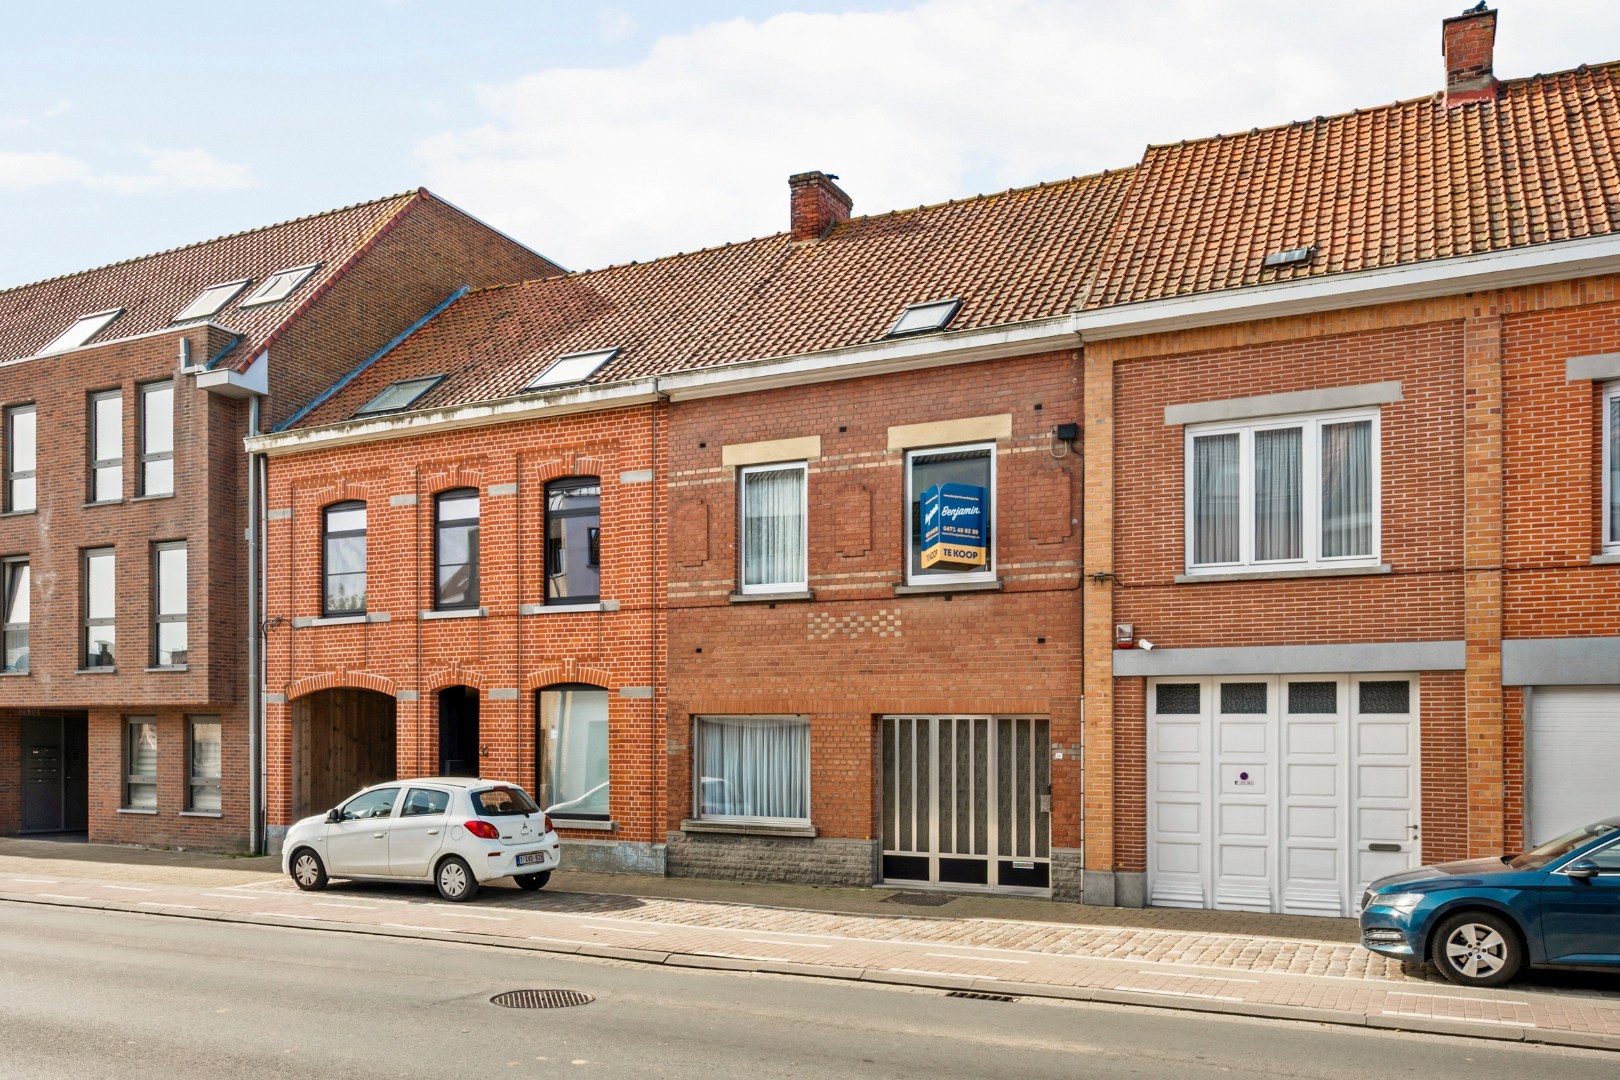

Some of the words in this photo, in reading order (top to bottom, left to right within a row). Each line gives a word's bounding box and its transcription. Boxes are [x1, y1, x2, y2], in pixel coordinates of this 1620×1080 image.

[942, 525, 956, 533] 0471
[943, 548, 952, 557] TE
[953, 549, 978, 559] KOOP
